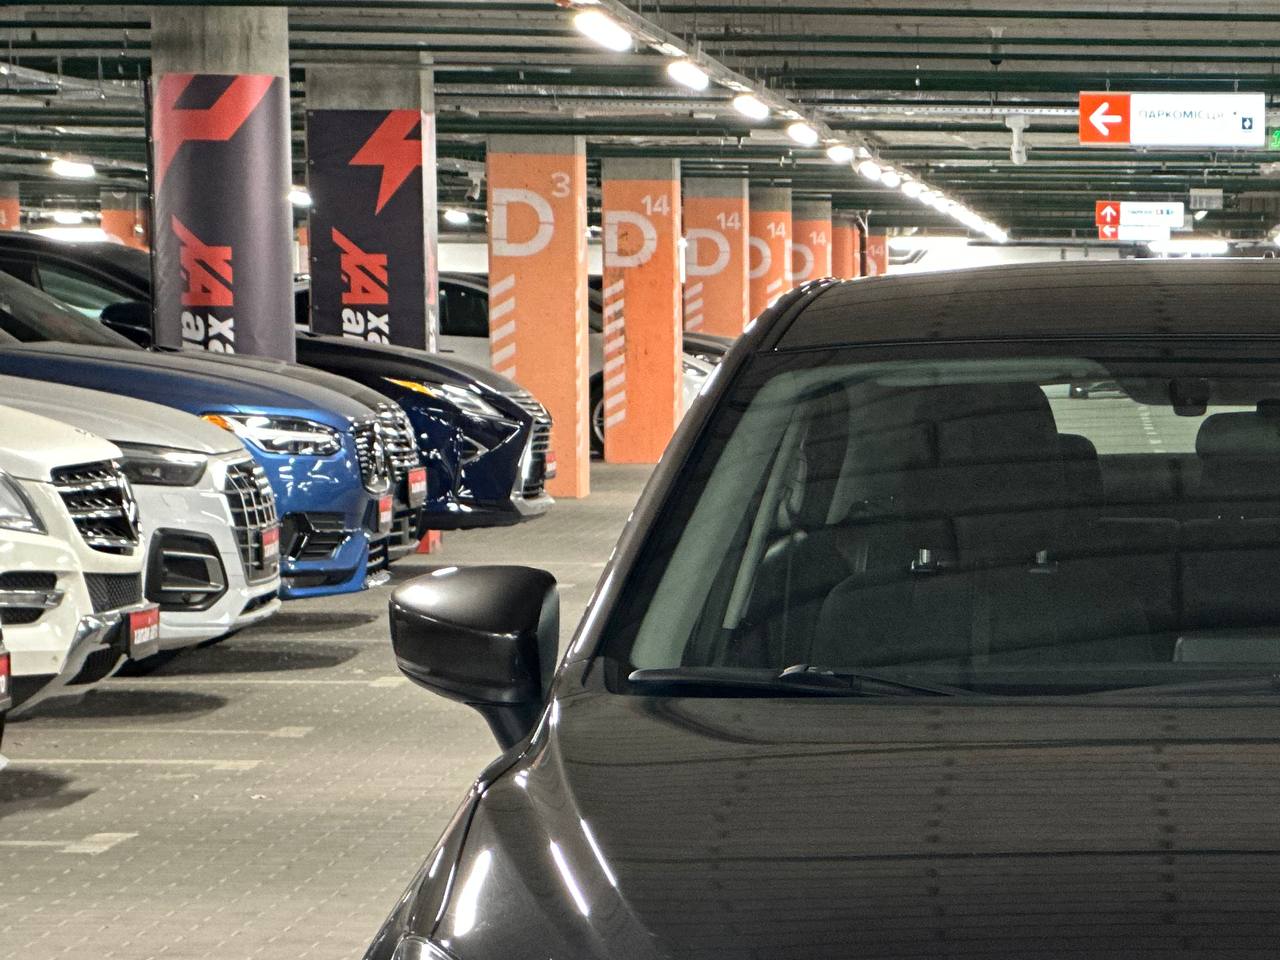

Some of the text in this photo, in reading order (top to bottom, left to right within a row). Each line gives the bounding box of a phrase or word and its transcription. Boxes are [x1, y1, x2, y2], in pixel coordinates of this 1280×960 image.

[550, 171, 571, 199] 3
[640, 194, 671, 217] 14
[715, 211, 742, 231] 14
[766, 222, 786, 239] 14
